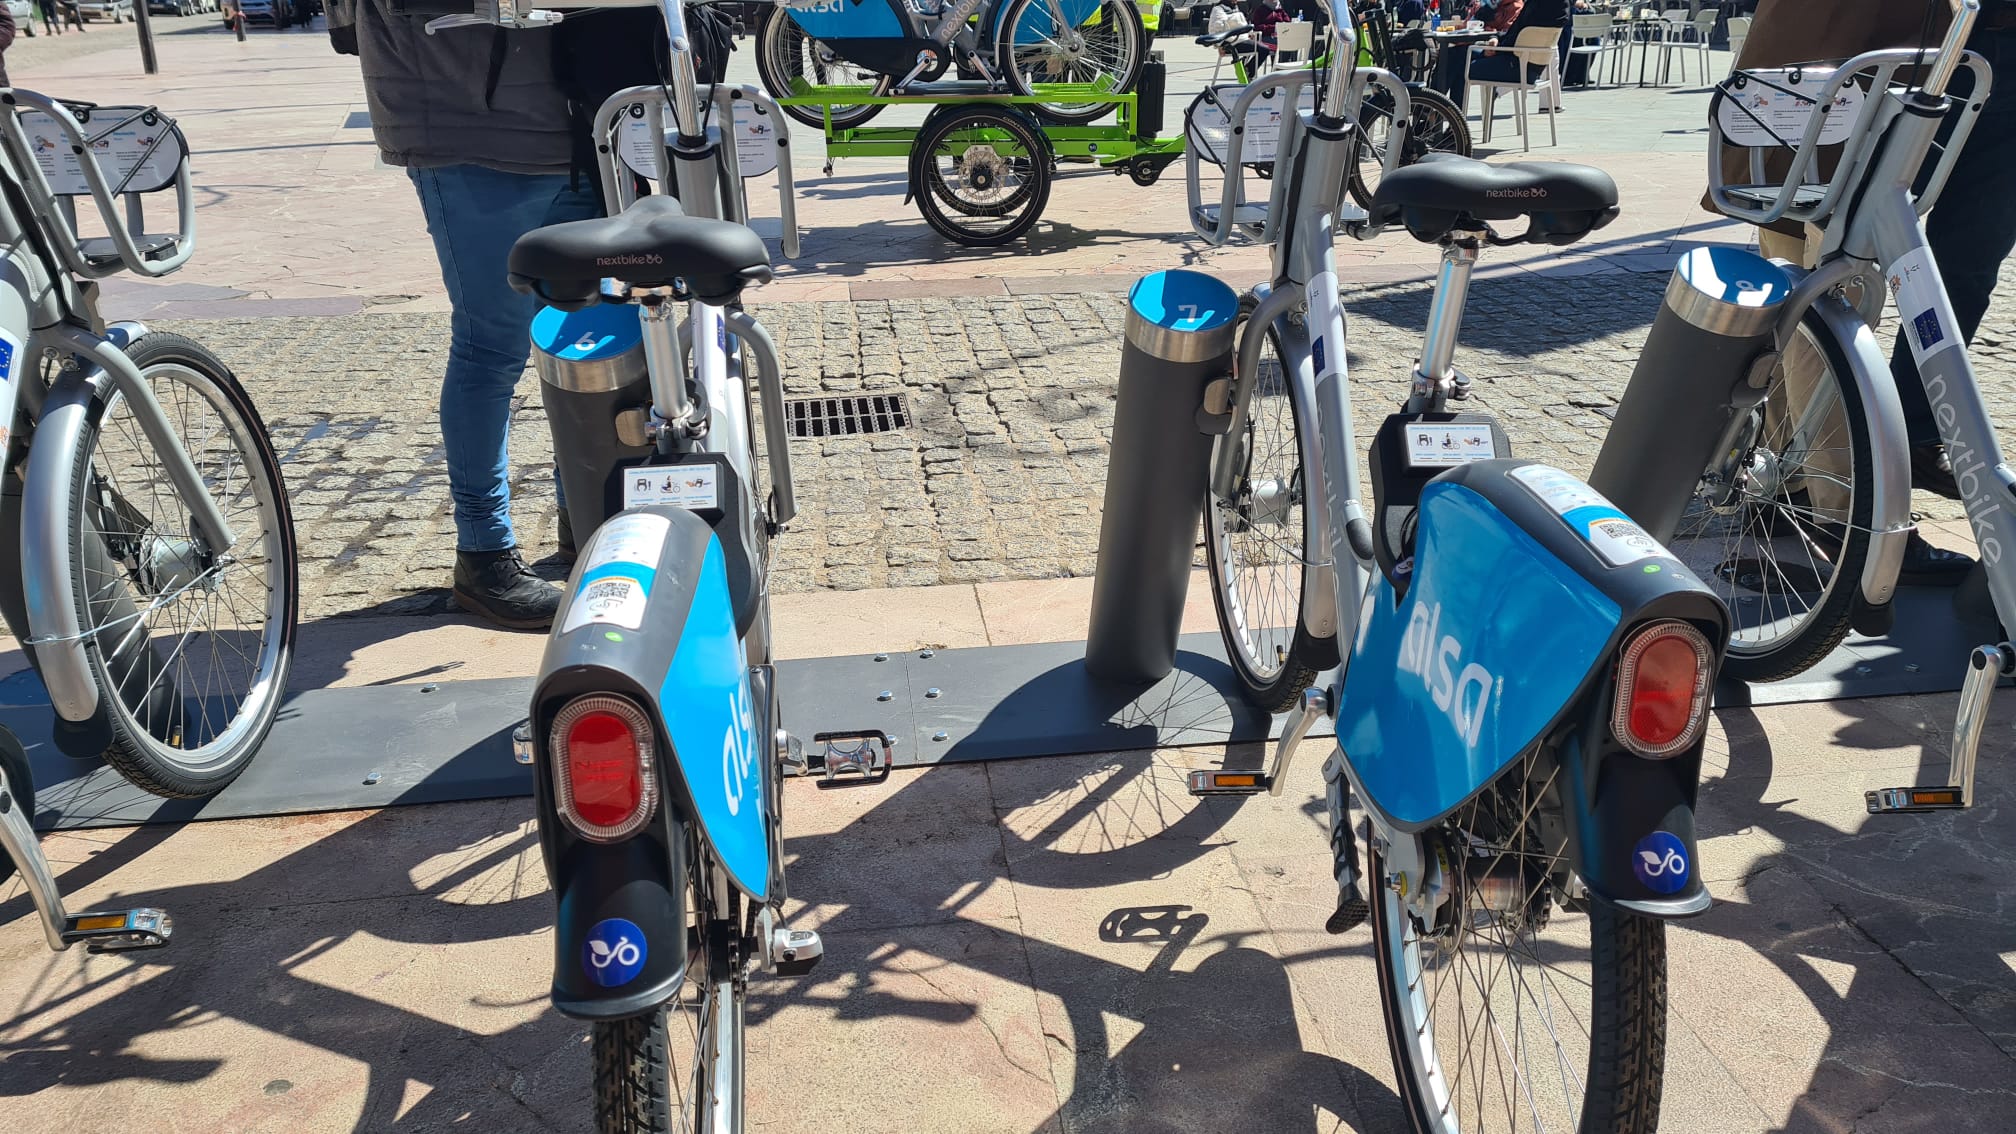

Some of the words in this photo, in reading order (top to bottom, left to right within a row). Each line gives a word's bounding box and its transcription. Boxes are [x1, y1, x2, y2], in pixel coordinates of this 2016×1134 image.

[1486, 187, 1530, 198] nextbike
[597, 254, 645, 265] nextbike
[1178, 304, 1198, 323] 7
[575, 331, 595, 351] 6
[1926, 373, 2002, 568] nextbike
[1408, 601, 1493, 747] alsa
